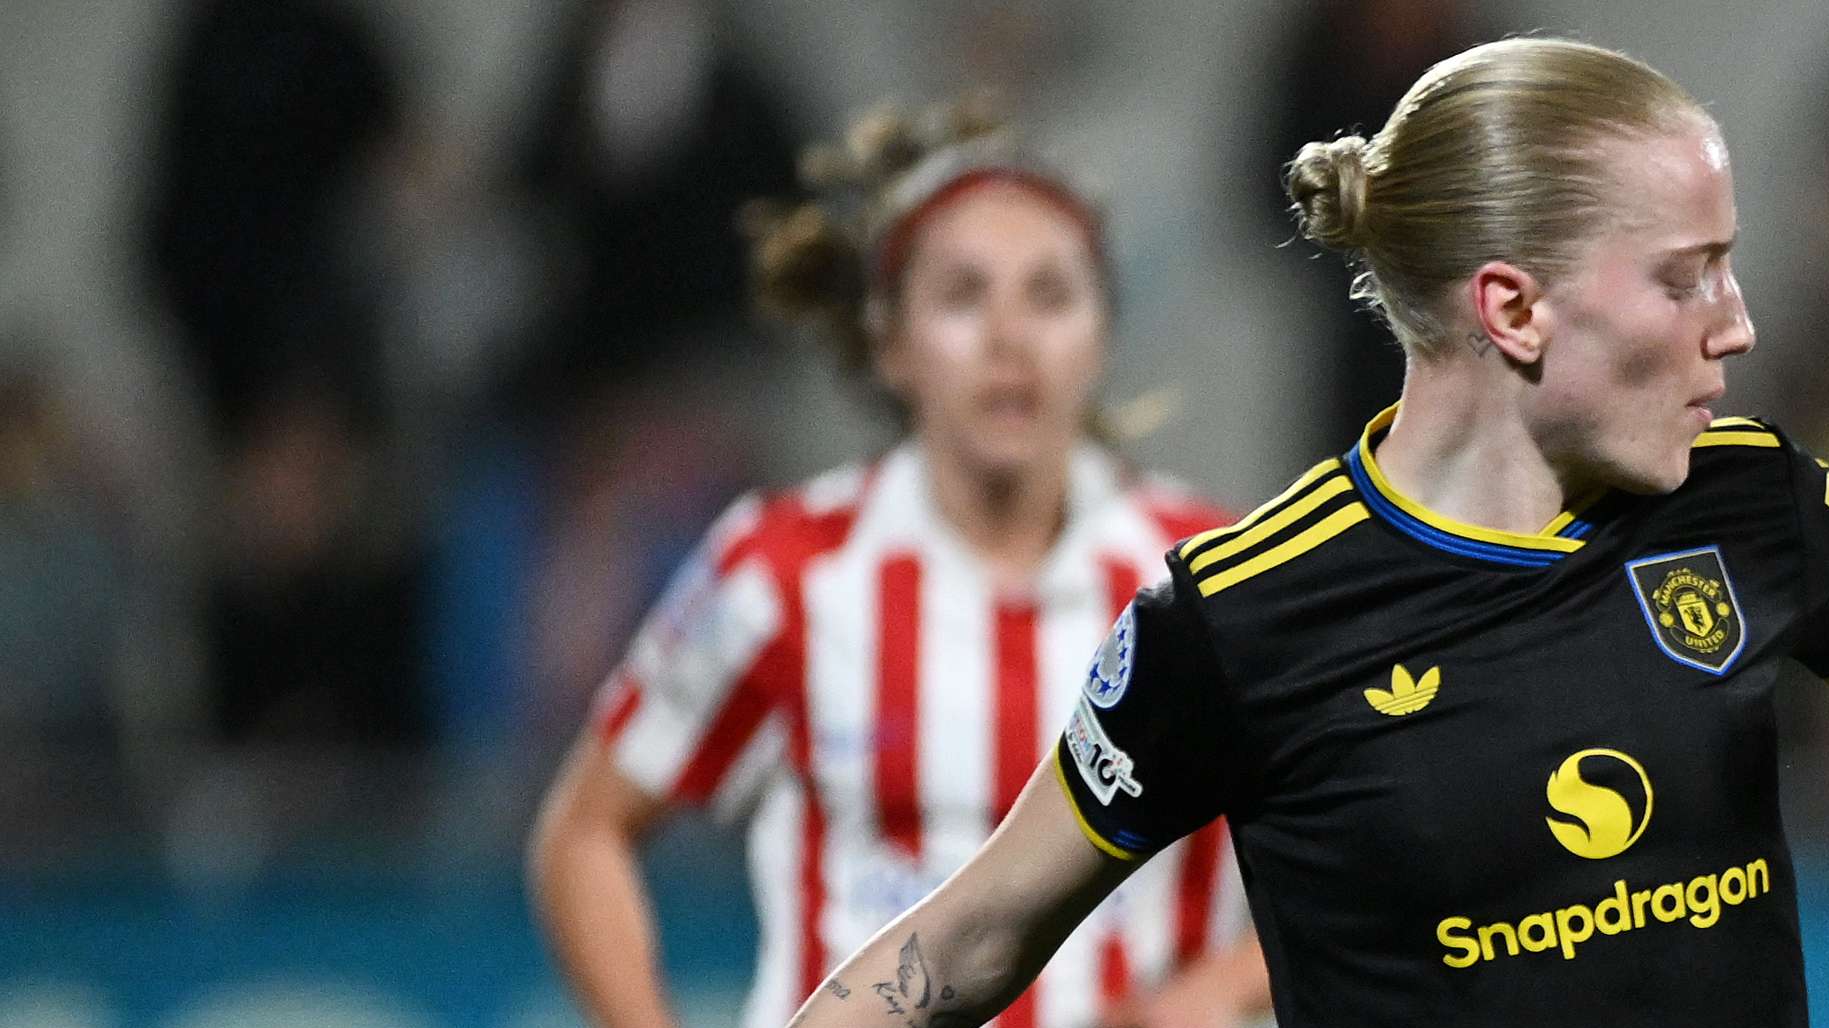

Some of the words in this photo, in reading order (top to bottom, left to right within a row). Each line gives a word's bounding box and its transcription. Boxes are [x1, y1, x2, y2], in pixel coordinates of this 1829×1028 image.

[1659, 575, 1717, 607] MANCHESTER
[1685, 629, 1726, 649] UNITED
[1436, 858, 1771, 969] Snapdragon
